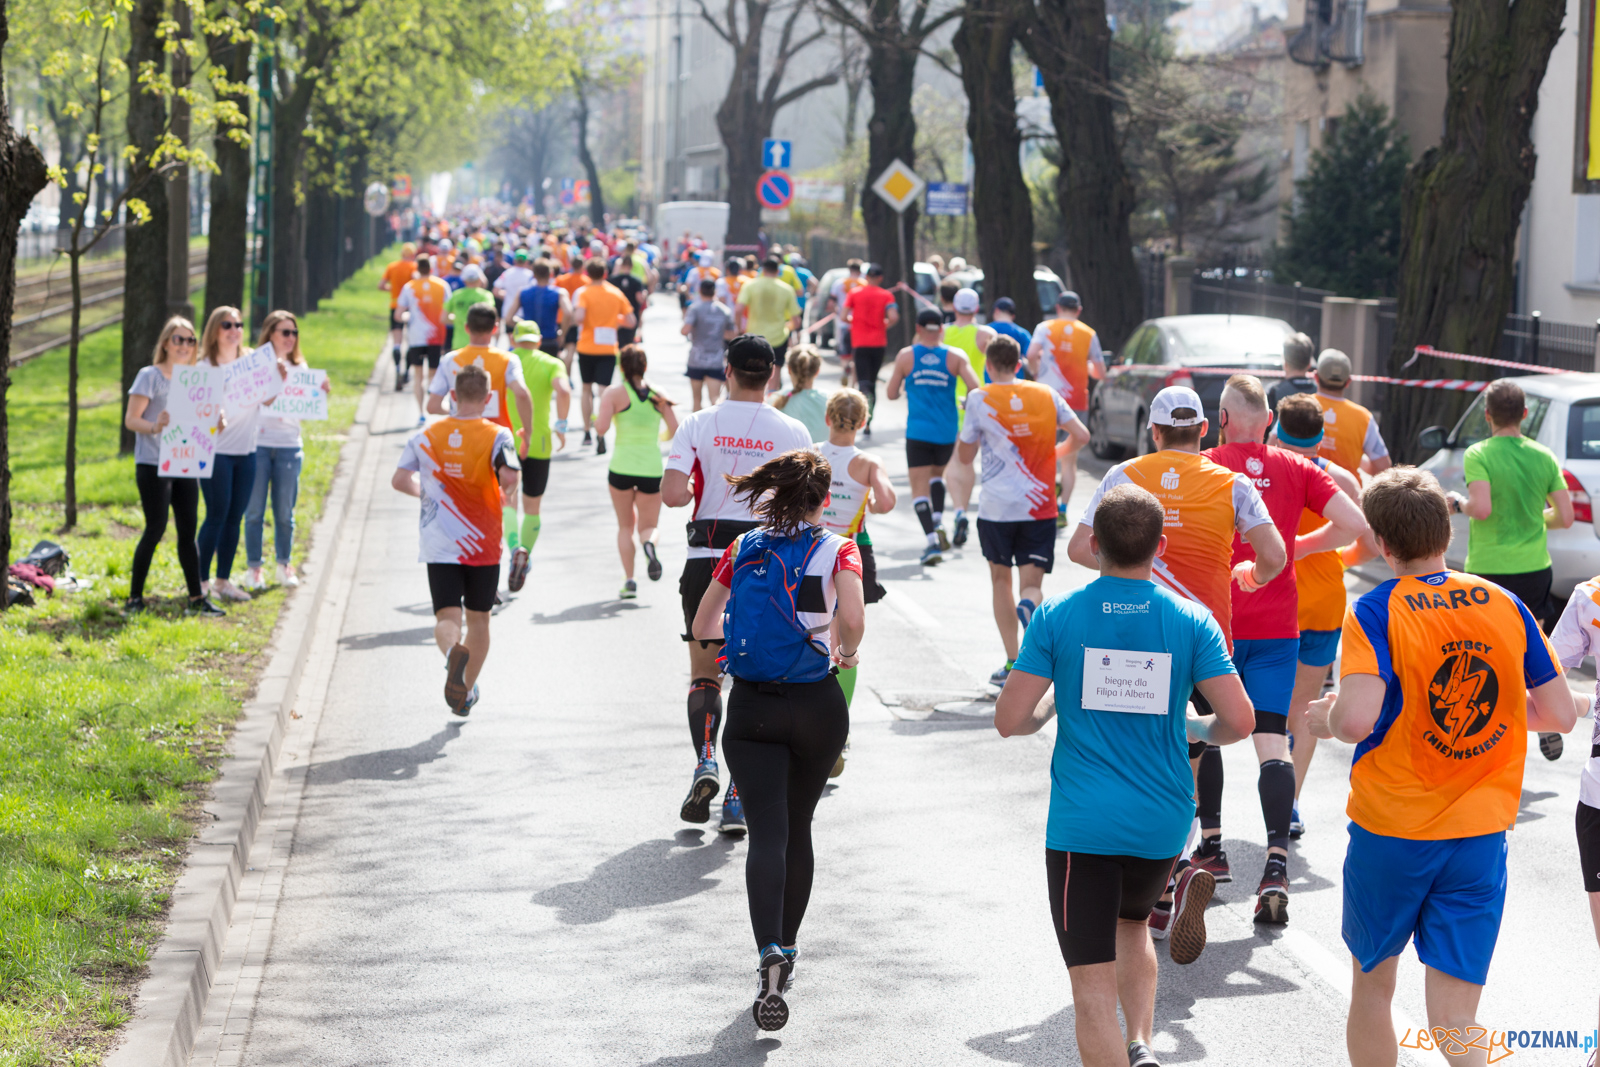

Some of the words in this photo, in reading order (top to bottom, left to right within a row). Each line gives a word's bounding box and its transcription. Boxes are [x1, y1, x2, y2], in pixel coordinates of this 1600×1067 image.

[179, 370, 208, 388] GO!
[292, 371, 318, 386] STILL
[188, 386, 213, 403] GO!
[282, 385, 306, 398] OOK
[195, 402, 220, 420] GO!
[163, 424, 184, 445] TIM
[713, 435, 775, 452] STRABAG
[720, 447, 742, 456] TEAMS
[744, 449, 766, 458] WORK
[1404, 586, 1491, 612] MARO
[1102, 602, 1112, 614] 8
[1440, 640, 1494, 656] SZYBCY
[1104, 676, 1132, 688] biegnę
[1134, 678, 1148, 687] dla
[1096, 686, 1118, 698] Filipa
[1120, 688, 1122, 697] i
[1124, 689, 1155, 699] Alberta
